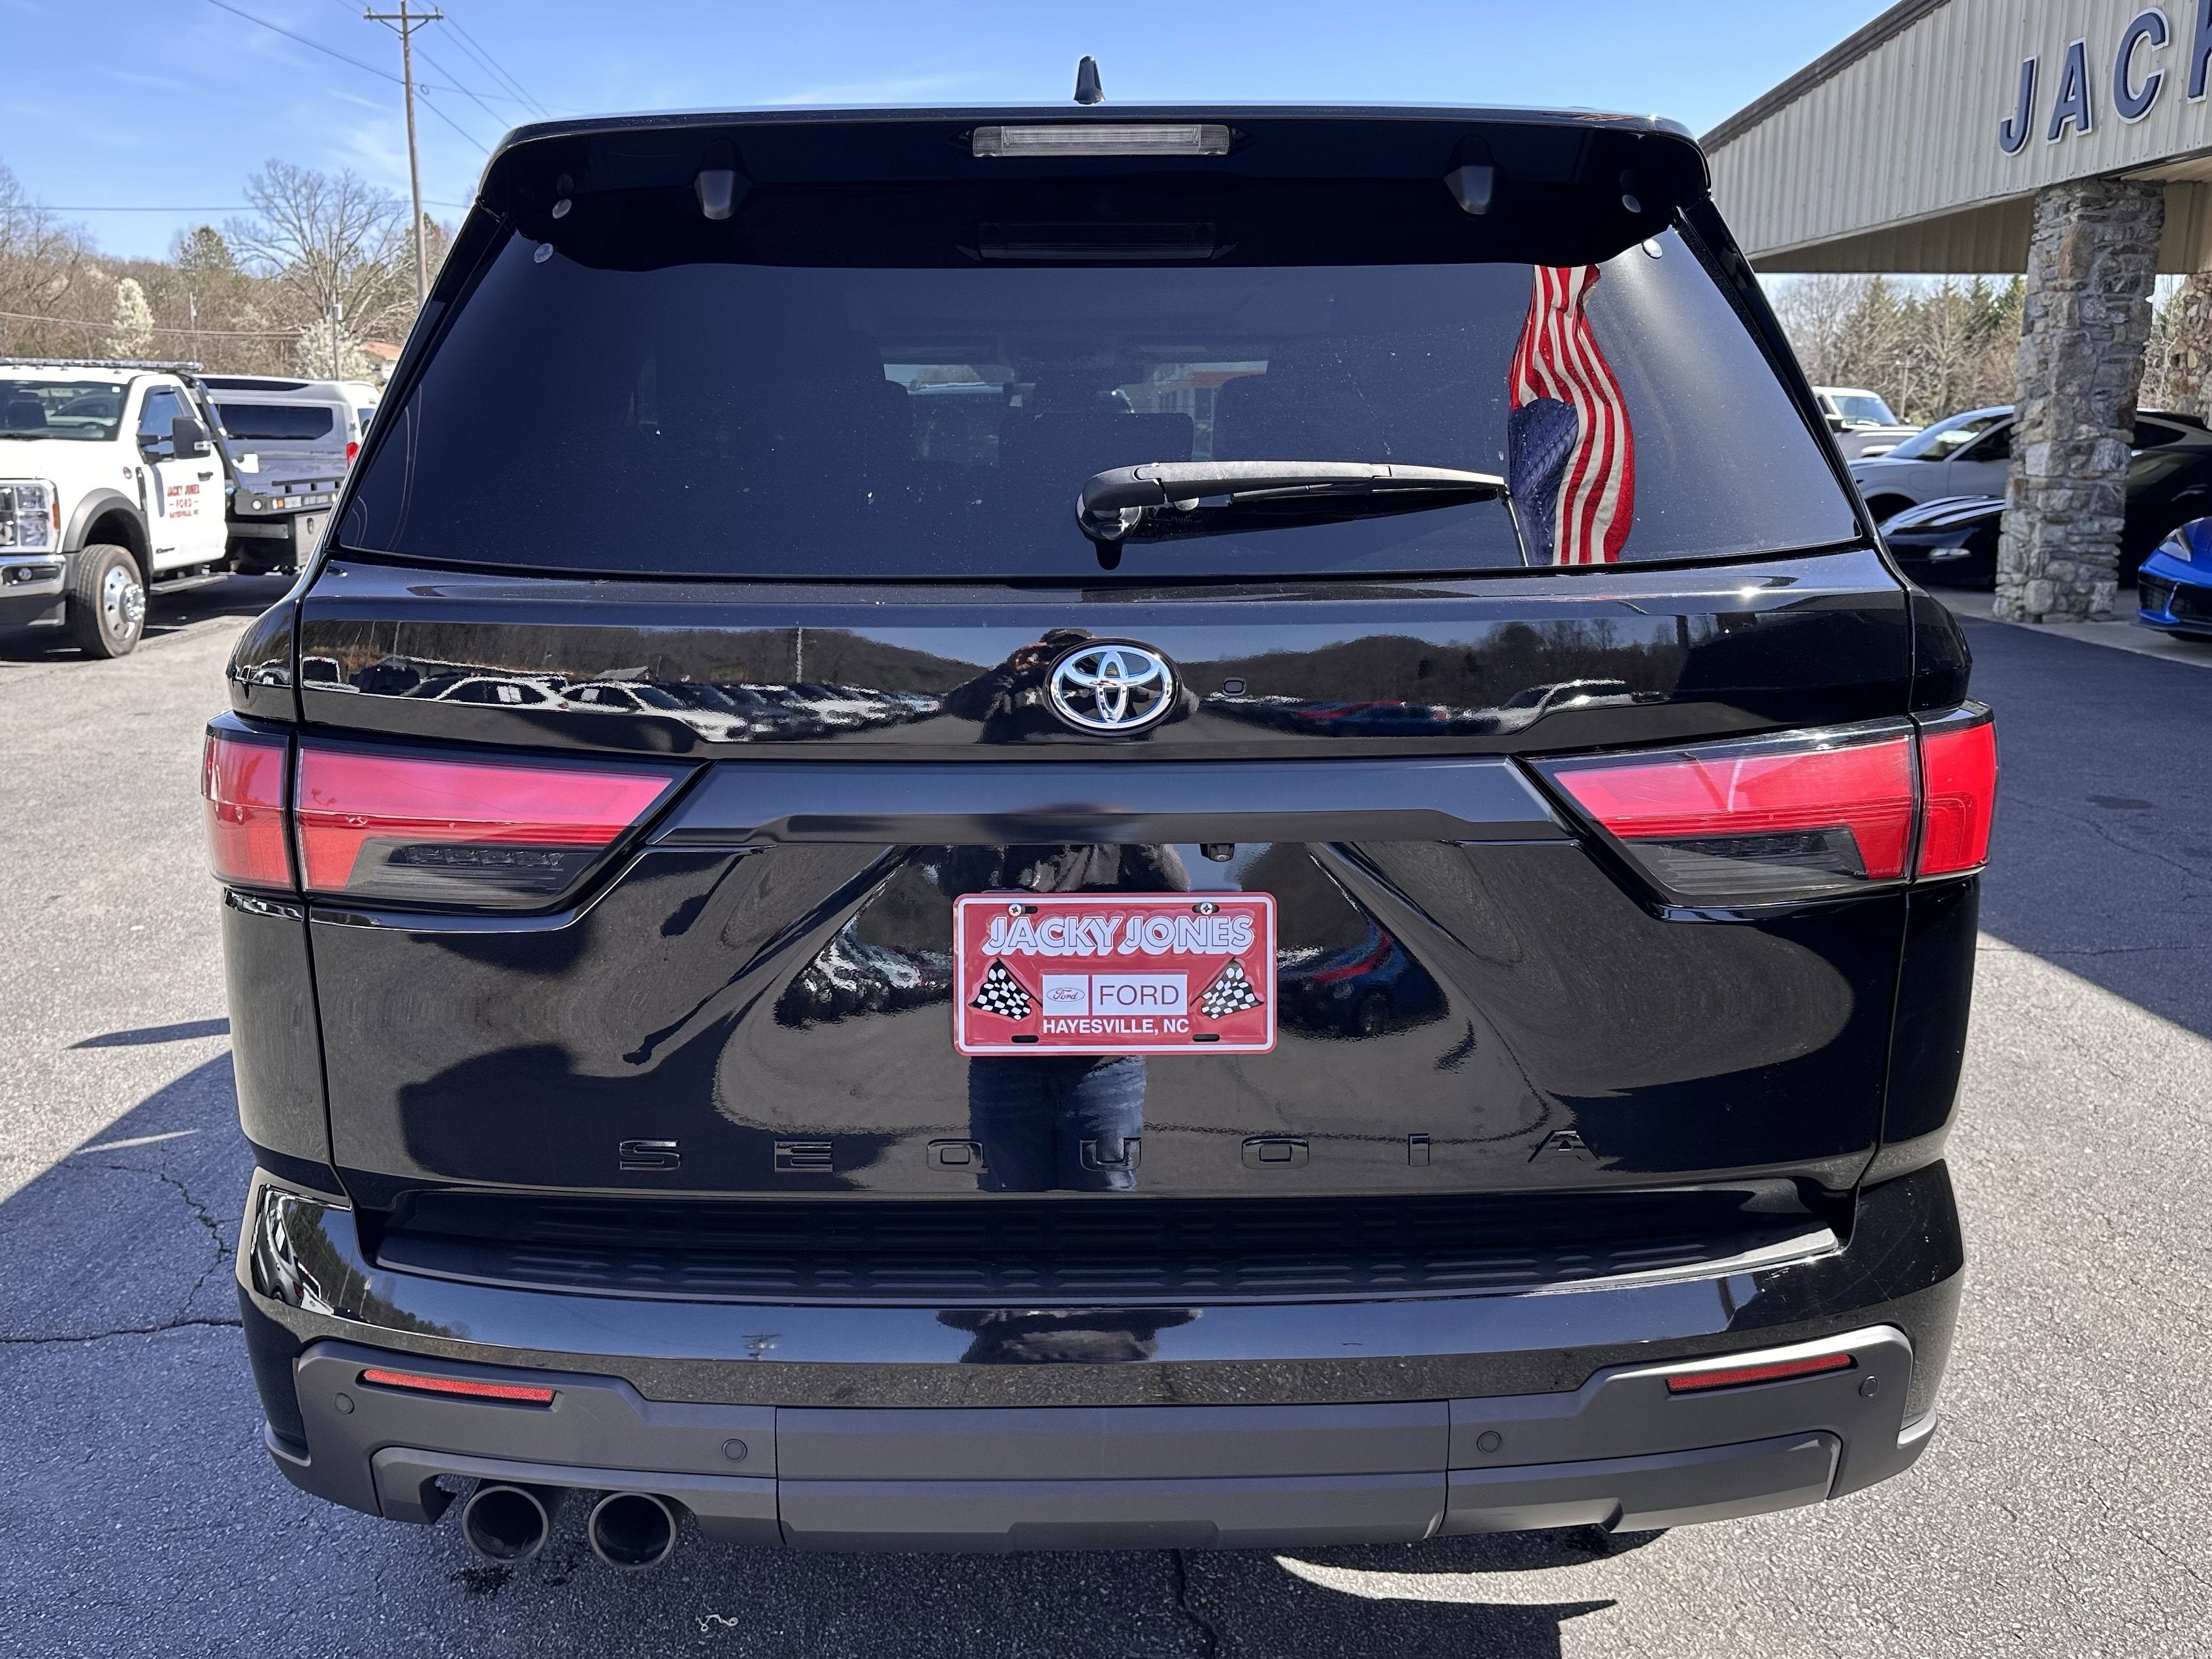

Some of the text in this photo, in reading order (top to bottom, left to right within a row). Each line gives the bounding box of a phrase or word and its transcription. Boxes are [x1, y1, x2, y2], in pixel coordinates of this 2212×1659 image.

[982, 915, 1255, 956] JACKY JONES
[1054, 988, 1078, 1001] Ford
[1100, 985, 1179, 1005] FORD
[1043, 1018, 1190, 1035] HAYESVILLE, NC
[619, 1129, 1599, 1174] SEQUOIA
